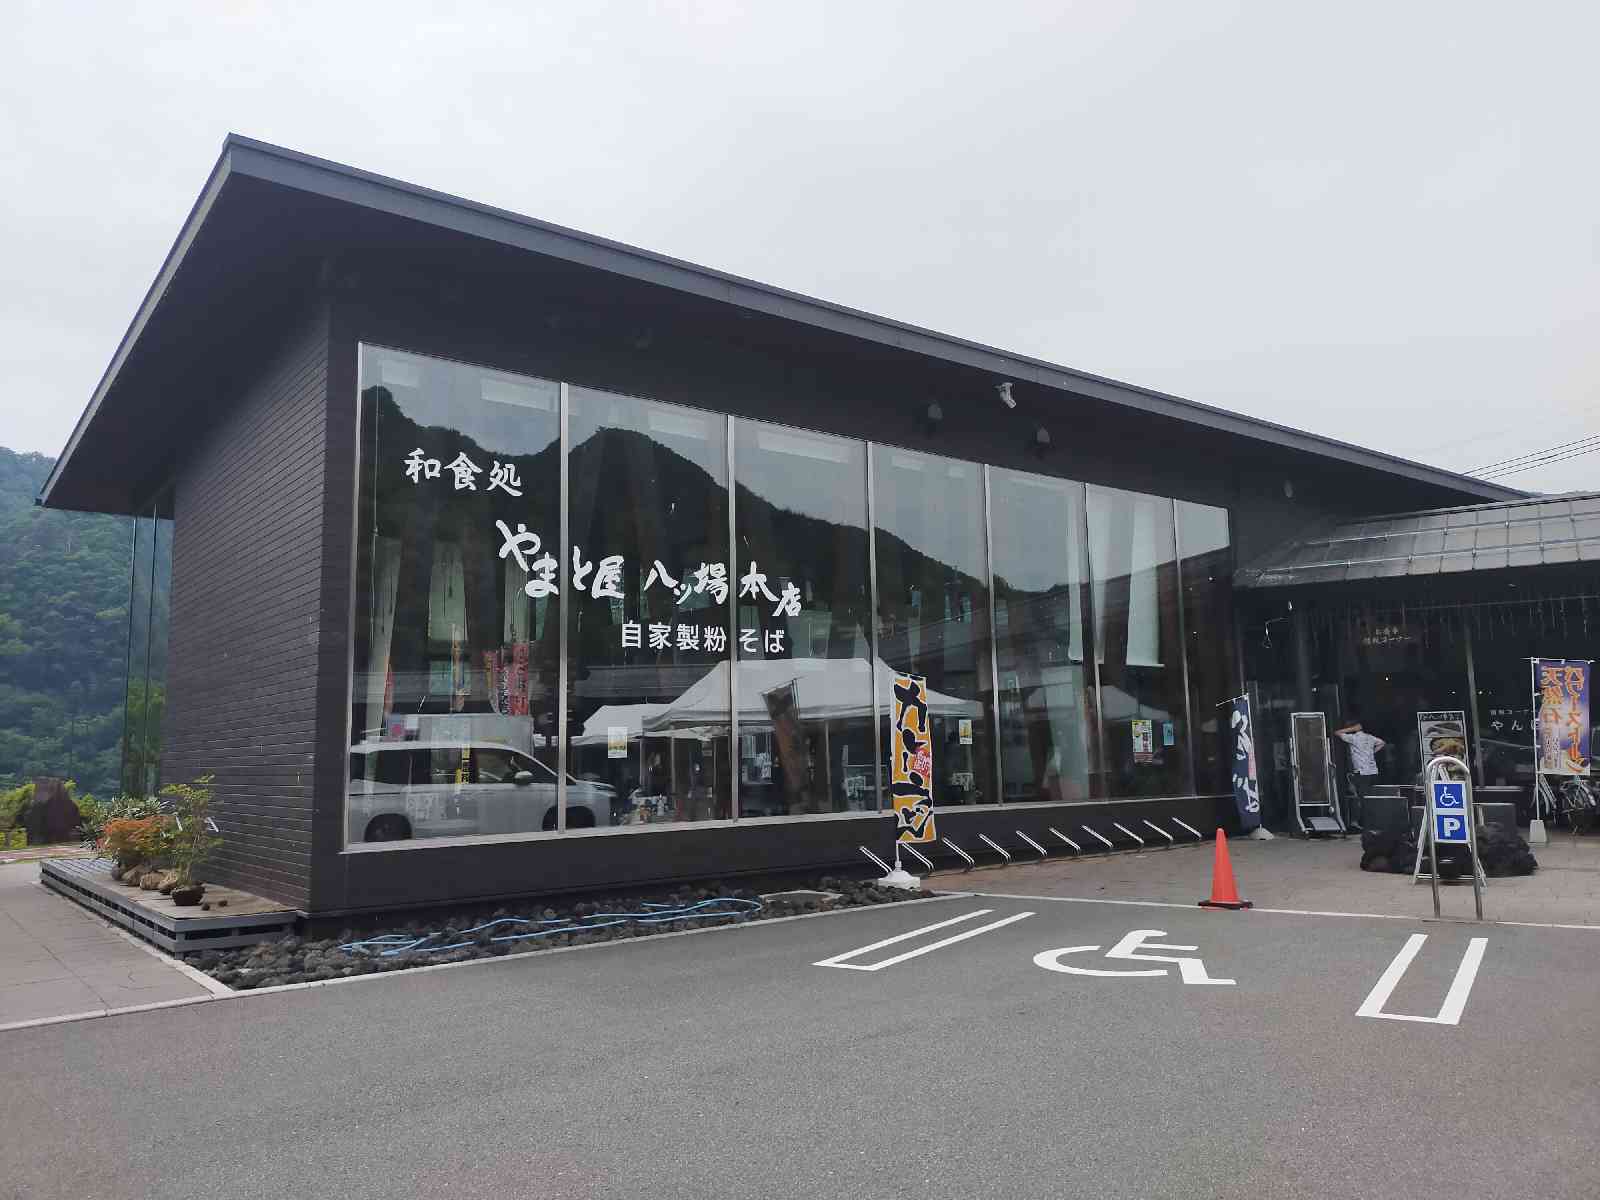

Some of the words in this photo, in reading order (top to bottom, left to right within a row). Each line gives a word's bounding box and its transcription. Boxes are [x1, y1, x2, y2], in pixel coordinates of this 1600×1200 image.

[403, 447, 522, 497] 和食処
[495, 519, 625, 600] やまと屋
[643, 559, 801, 617] 八ッ場本店
[1443, 817, 1460, 837] P
